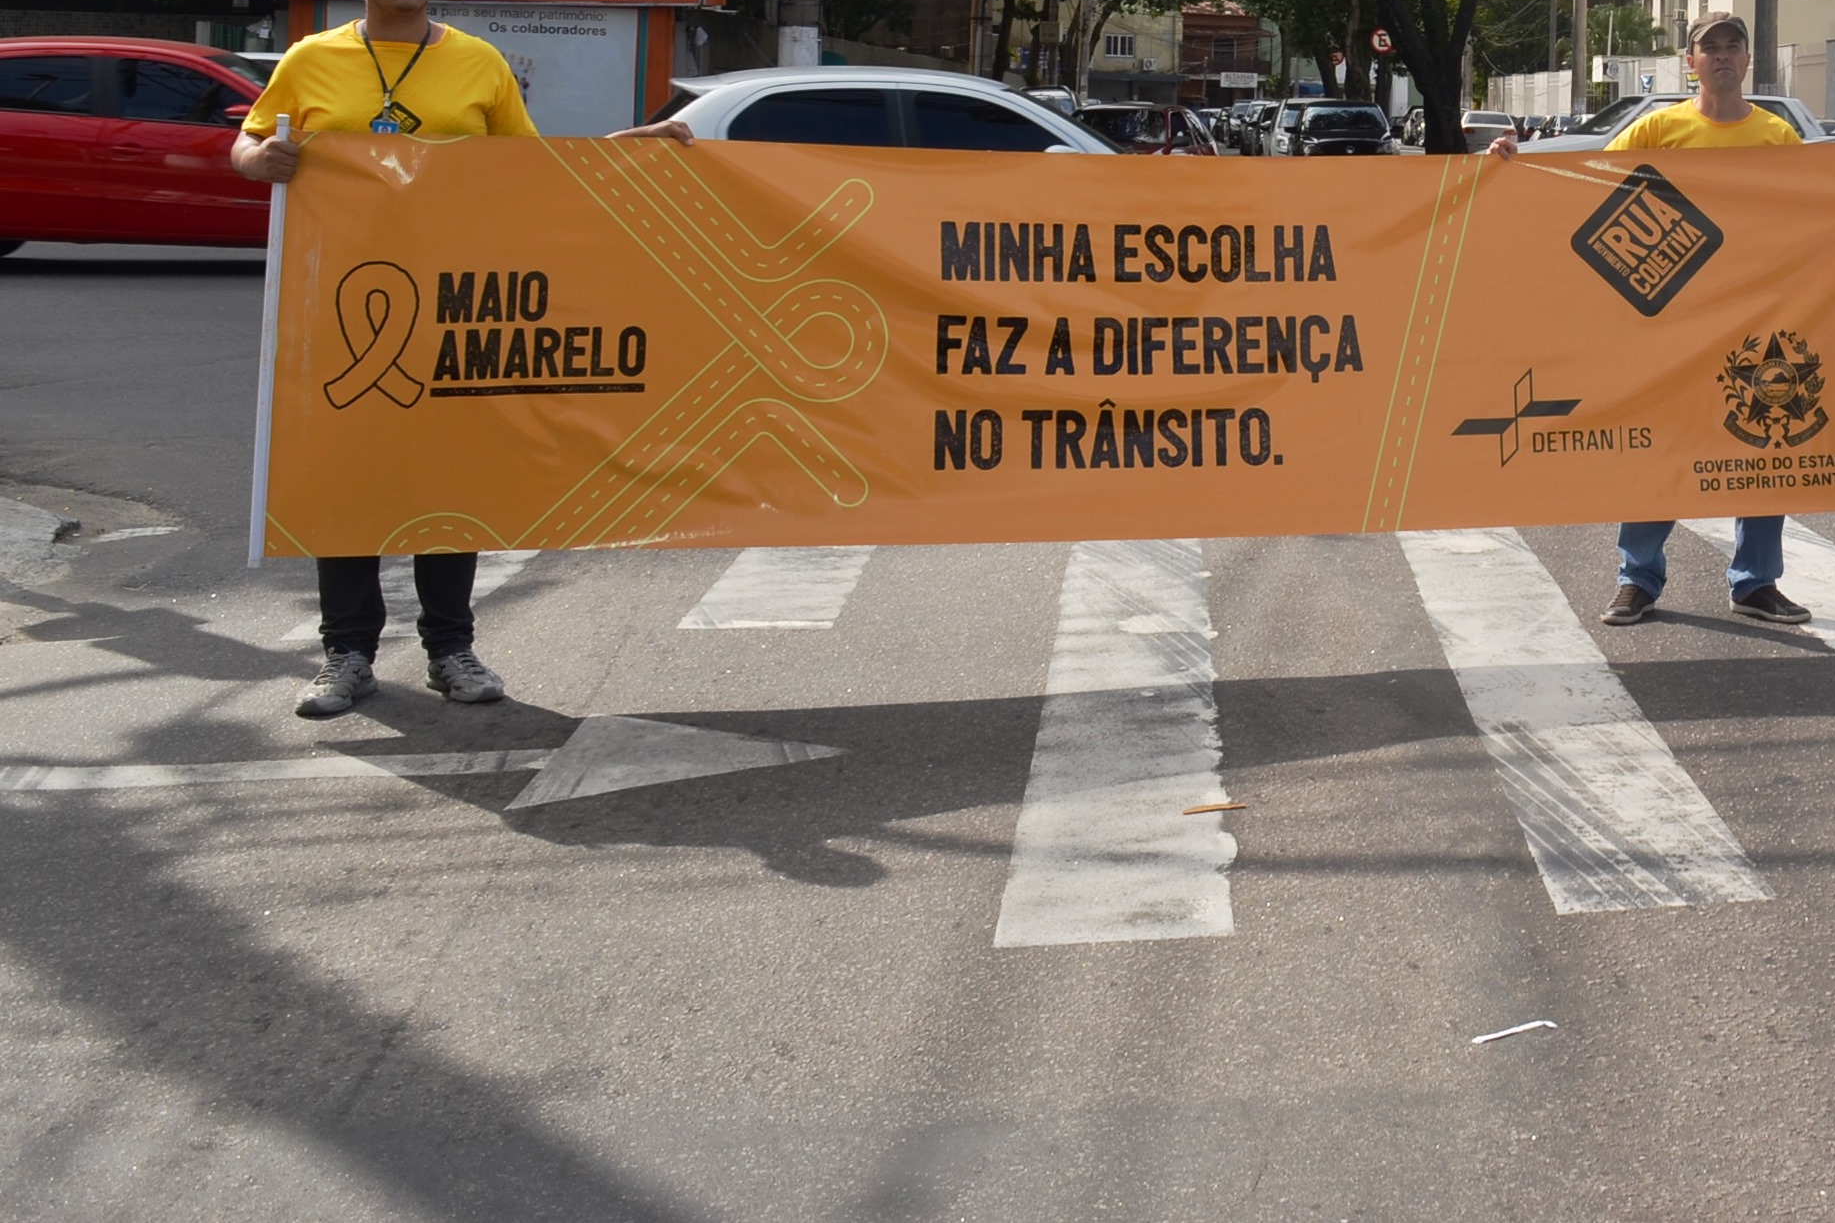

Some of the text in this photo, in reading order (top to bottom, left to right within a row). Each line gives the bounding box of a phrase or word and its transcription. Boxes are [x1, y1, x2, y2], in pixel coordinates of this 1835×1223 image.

[441, 8, 470, 21] para
[473, 8, 496, 18] seu
[500, 7, 535, 19] maior
[539, 8, 607, 23] patrimônio:
[488, 22, 607, 36] Os colaboradores
[940, 221, 1337, 283] MINHA ESCOLHA
[1601, 188, 1683, 269] RUA
[1591, 240, 1631, 277] MOVIMENTO
[436, 270, 549, 324] MAIO
[432, 325, 647, 382] AMARELO
[935, 314, 1364, 383] FAZ A DIFERENÇA
[934, 398, 1284, 471] NO TRÂNSITO.
[1693, 457, 1767, 474] GOVERNO
[1772, 456, 1793, 470] DO
[1700, 478, 1721, 492] DO
[1726, 473, 1797, 491] ESPÍRITO
